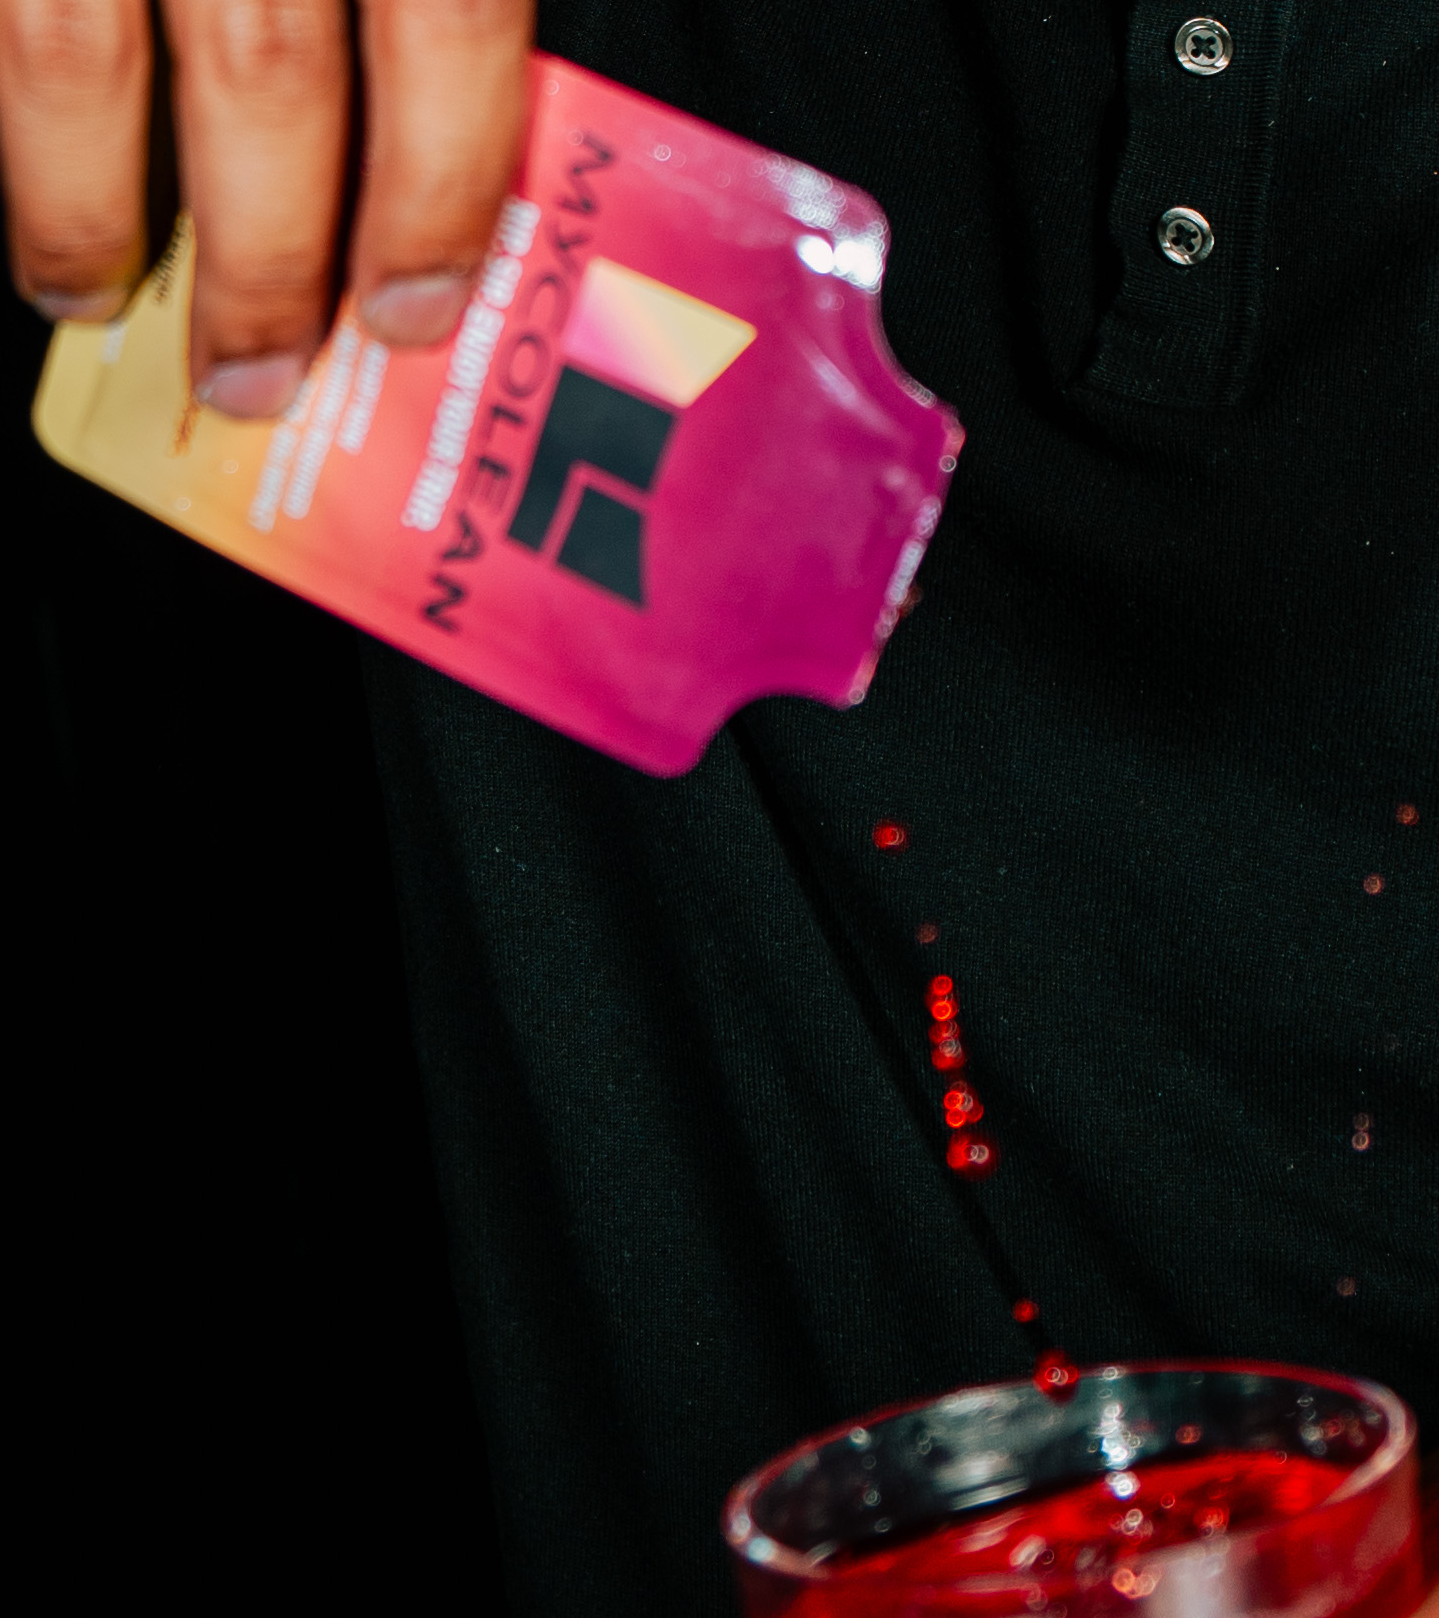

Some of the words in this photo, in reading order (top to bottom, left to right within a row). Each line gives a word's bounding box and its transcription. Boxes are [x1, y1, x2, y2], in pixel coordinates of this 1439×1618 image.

[415, 127, 618, 634] MYCOLEAN
[448, 306, 504, 393] ENJOY
[429, 390, 477, 462] YOUR
[403, 460, 453, 530] TRIP.
